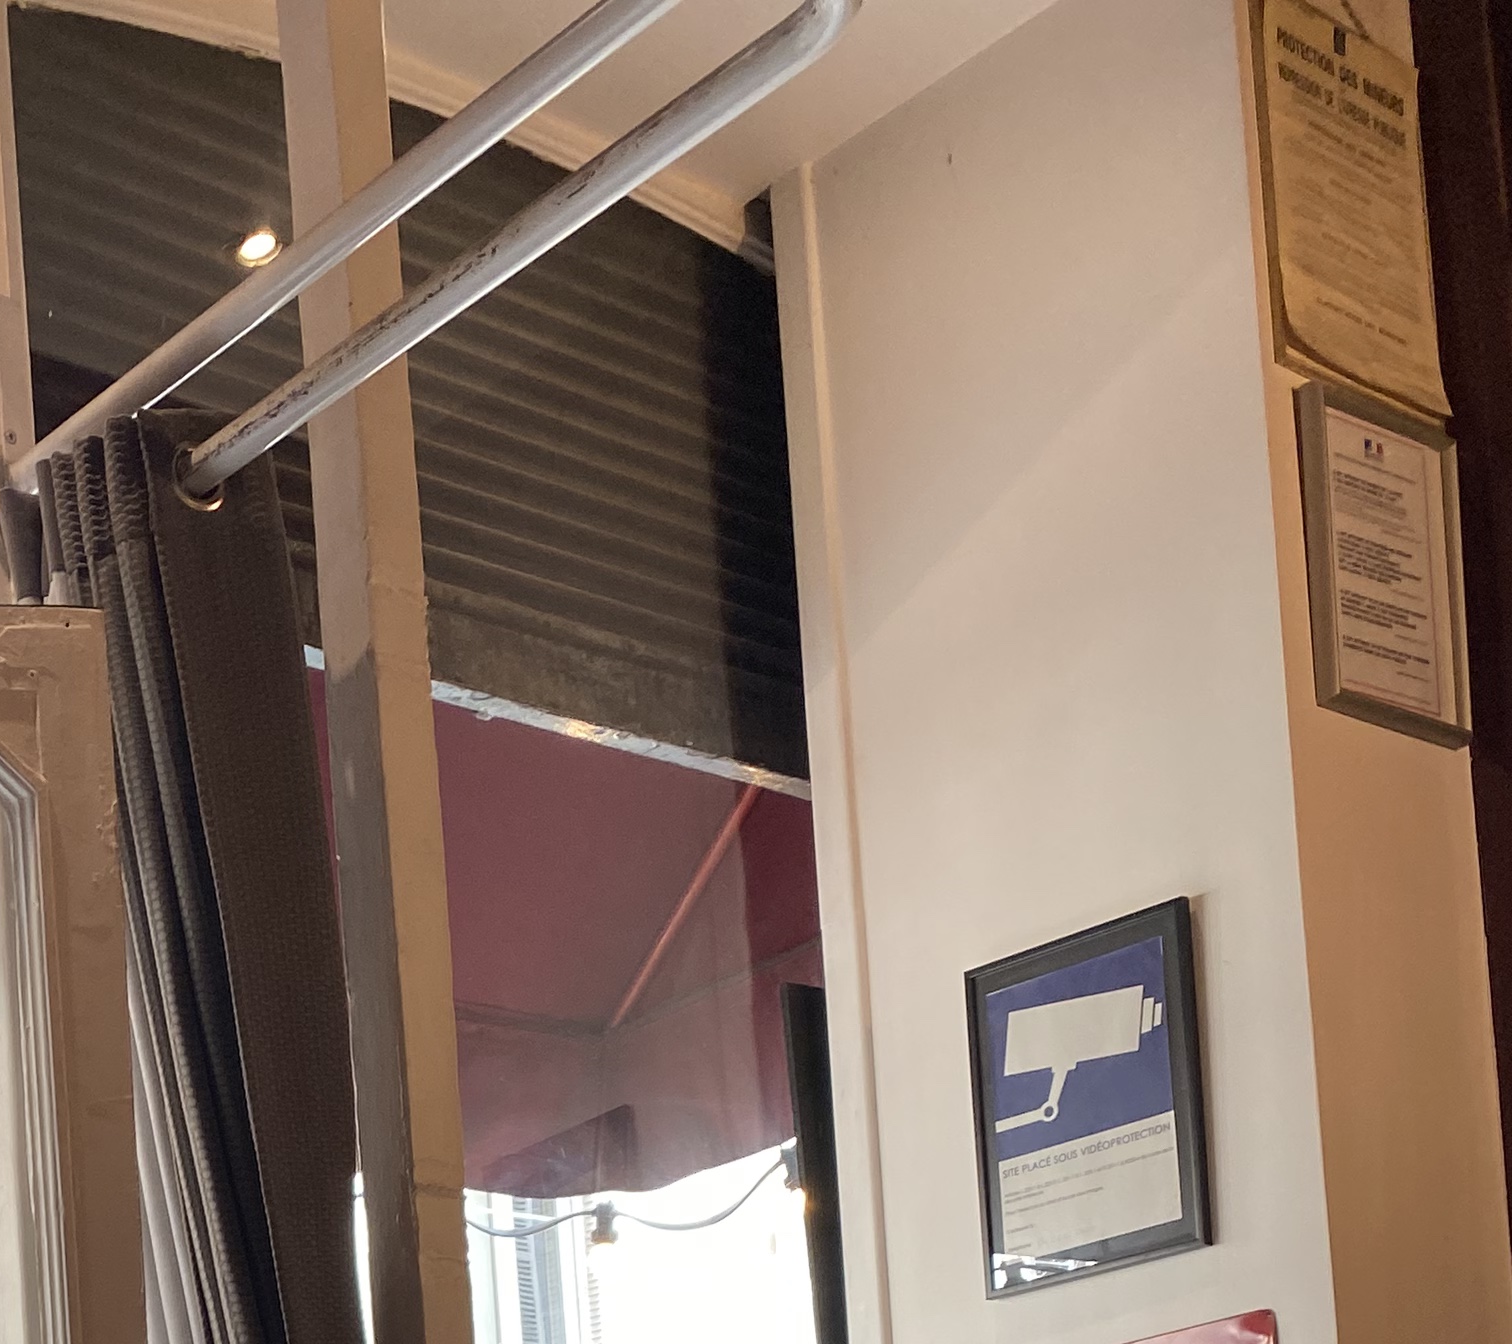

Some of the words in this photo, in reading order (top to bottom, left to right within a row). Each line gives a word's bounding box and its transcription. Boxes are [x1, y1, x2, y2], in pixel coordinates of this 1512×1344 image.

[1002, 1165, 1020, 1179] SITE
[1022, 1156, 1051, 1173] PLACÉ
[1054, 1150, 1078, 1165] SOUS
[1081, 1122, 1172, 1155] VIDÉOPROTECTION
